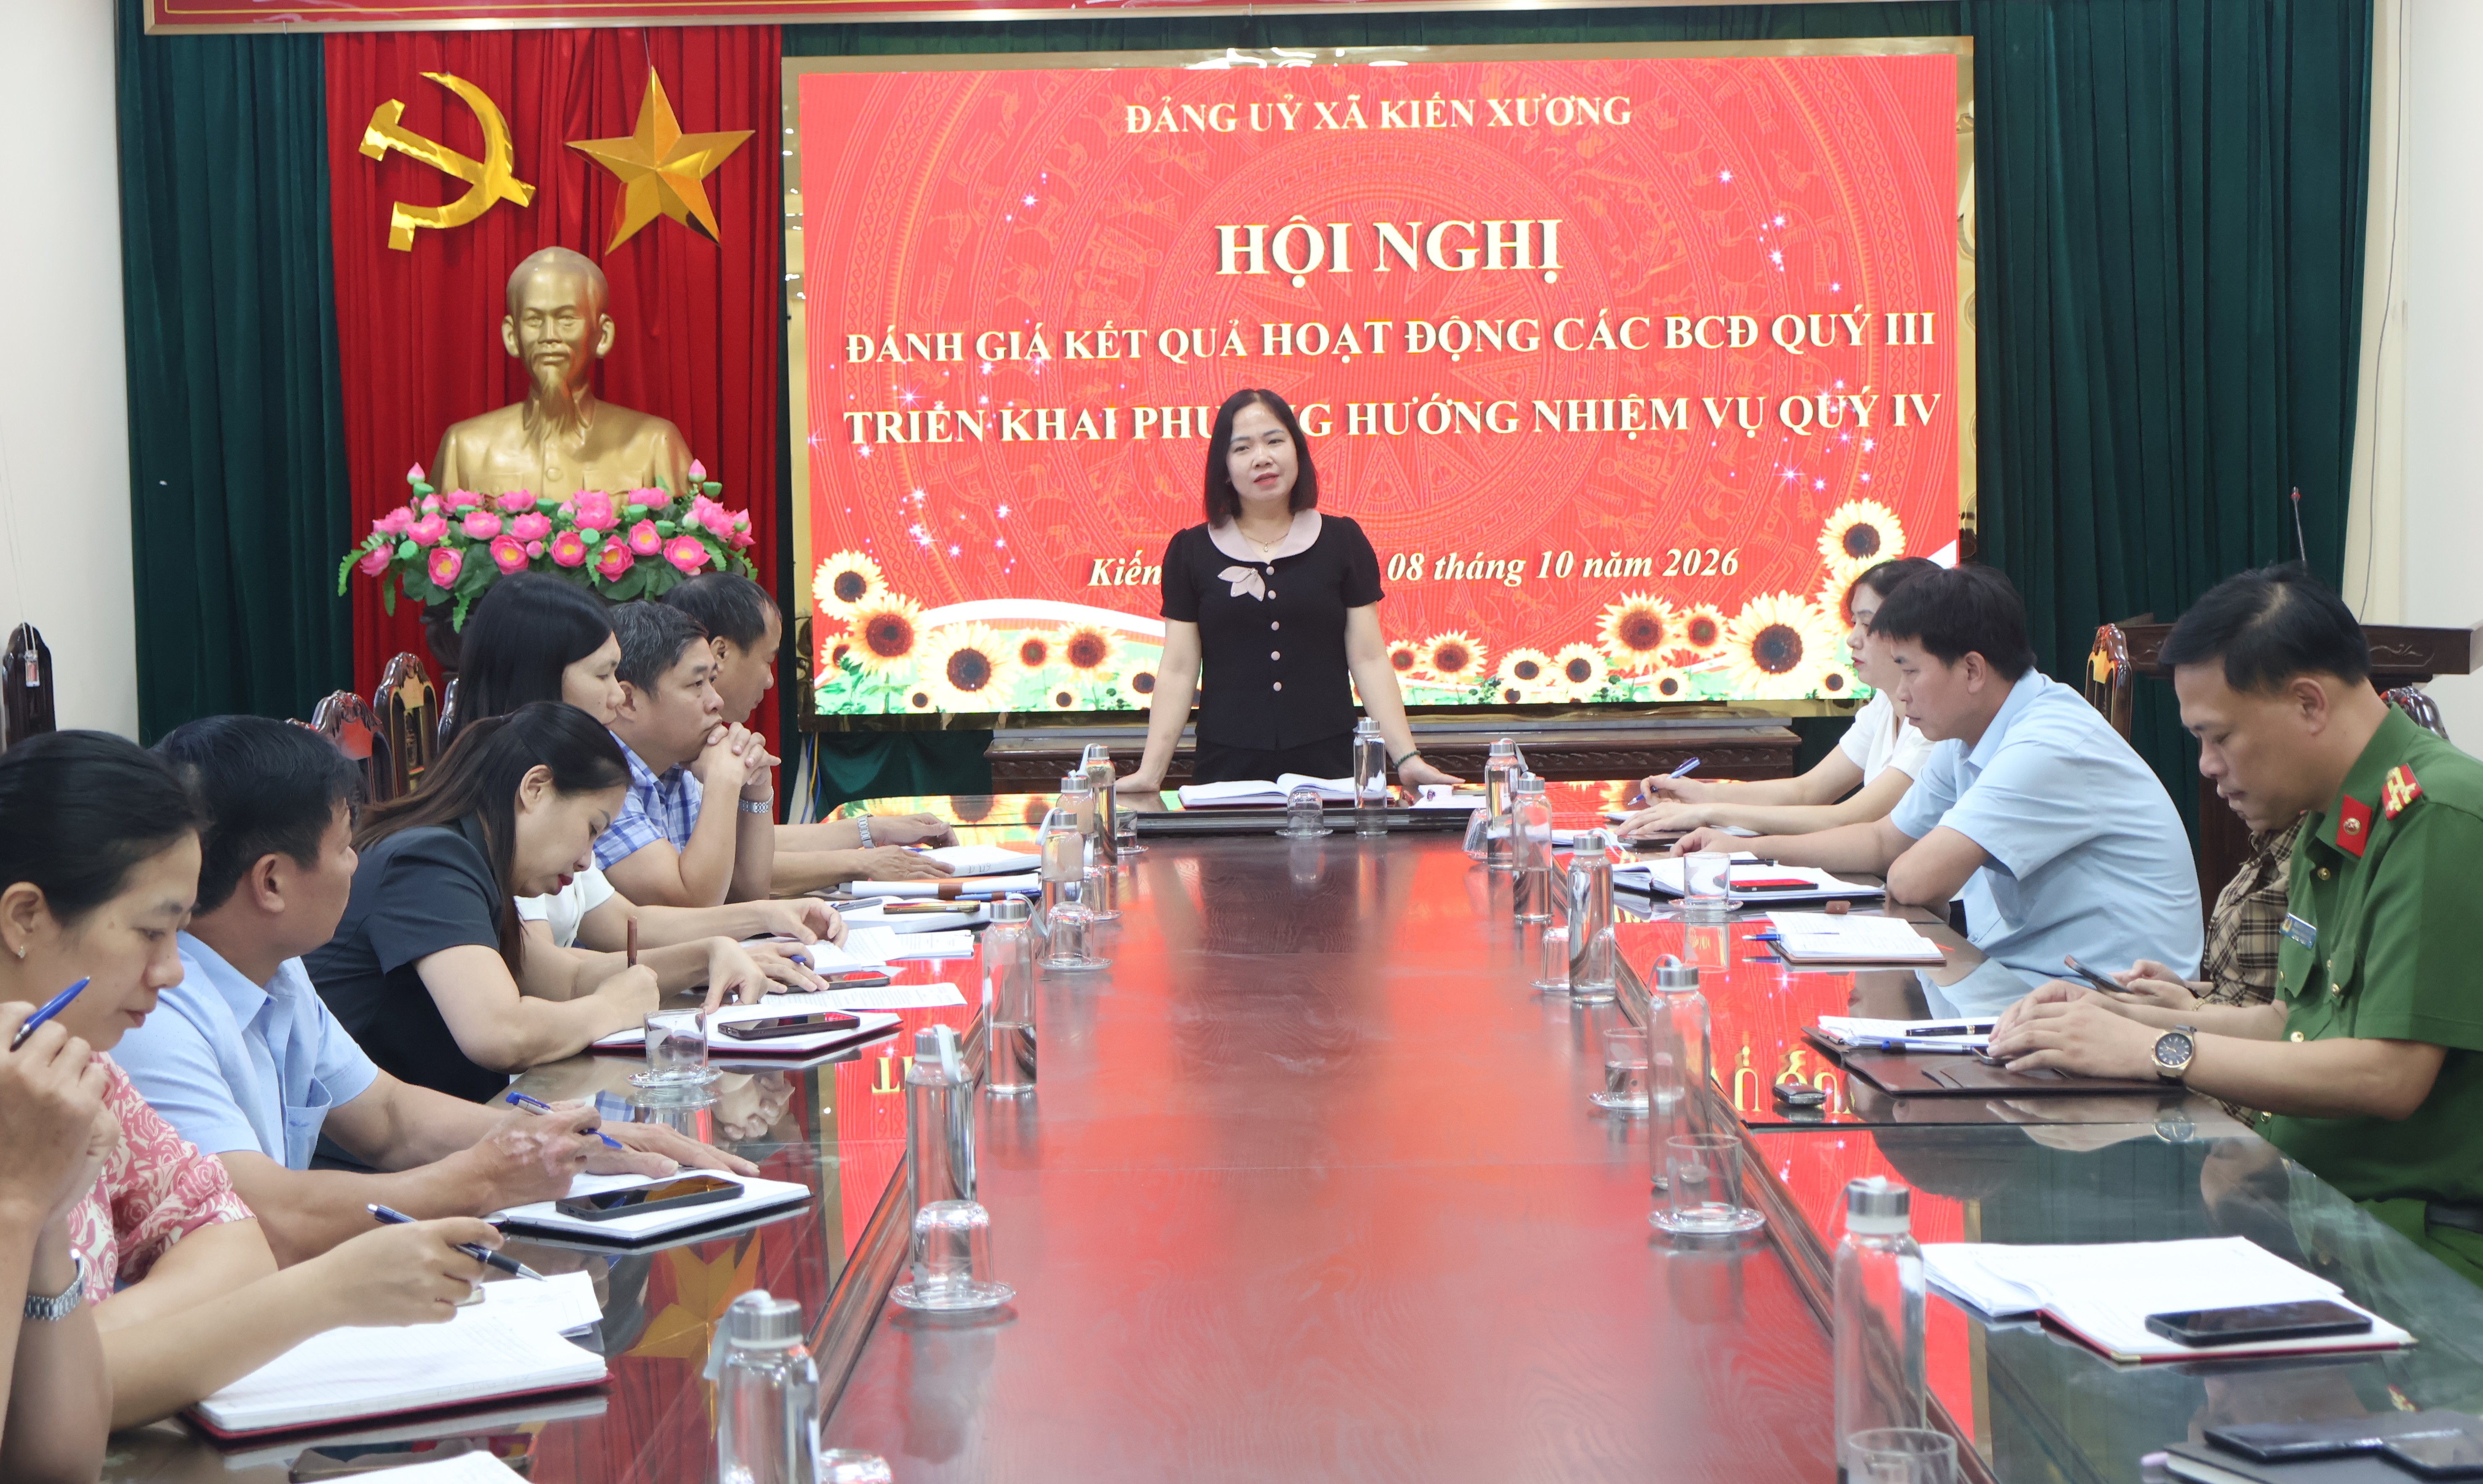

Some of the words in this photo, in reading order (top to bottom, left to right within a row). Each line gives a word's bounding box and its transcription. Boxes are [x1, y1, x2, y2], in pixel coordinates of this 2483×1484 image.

[1126, 96, 1237, 134] ĐẢNG
[1249, 94, 1303, 132] UỶ
[1313, 94, 1368, 130] XÃ
[1380, 92, 1475, 129] KIẾN
[1487, 93, 1632, 127] XƯƠNG
[1215, 215, 1353, 288] HỘI
[1372, 219, 1563, 284] NGHỊ
[846, 324, 964, 363] ĐÁNH
[976, 322, 1052, 362] GIÁ
[1065, 319, 1148, 359] KẾT
[1158, 319, 1247, 364] QUẢ
[1261, 320, 1393, 364] HOẠT
[1404, 315, 1541, 362] ĐỘNG
[1553, 308, 1650, 351] CÁC
[1664, 315, 1758, 349] BCĐ
[1771, 304, 1872, 355] QUÝ
[1885, 312, 1935, 345] III
[843, 400, 985, 445] TRIỂN
[999, 408, 1117, 442] KHAI
[1345, 392, 1519, 436] HƯỚNG
[1532, 393, 1688, 440] NHIỆM
[1702, 396, 1767, 438] VỤ
[1779, 385, 1879, 436] QUÝ
[1893, 393, 1941, 426] IV
[1088, 549, 1161, 586] Kiến
[1387, 553, 1425, 581] 08
[1434, 551, 1527, 587] tháng
[1538, 550, 1574, 579] 10
[1583, 550, 1653, 577] năm
[1662, 548, 1738, 577] 2026
